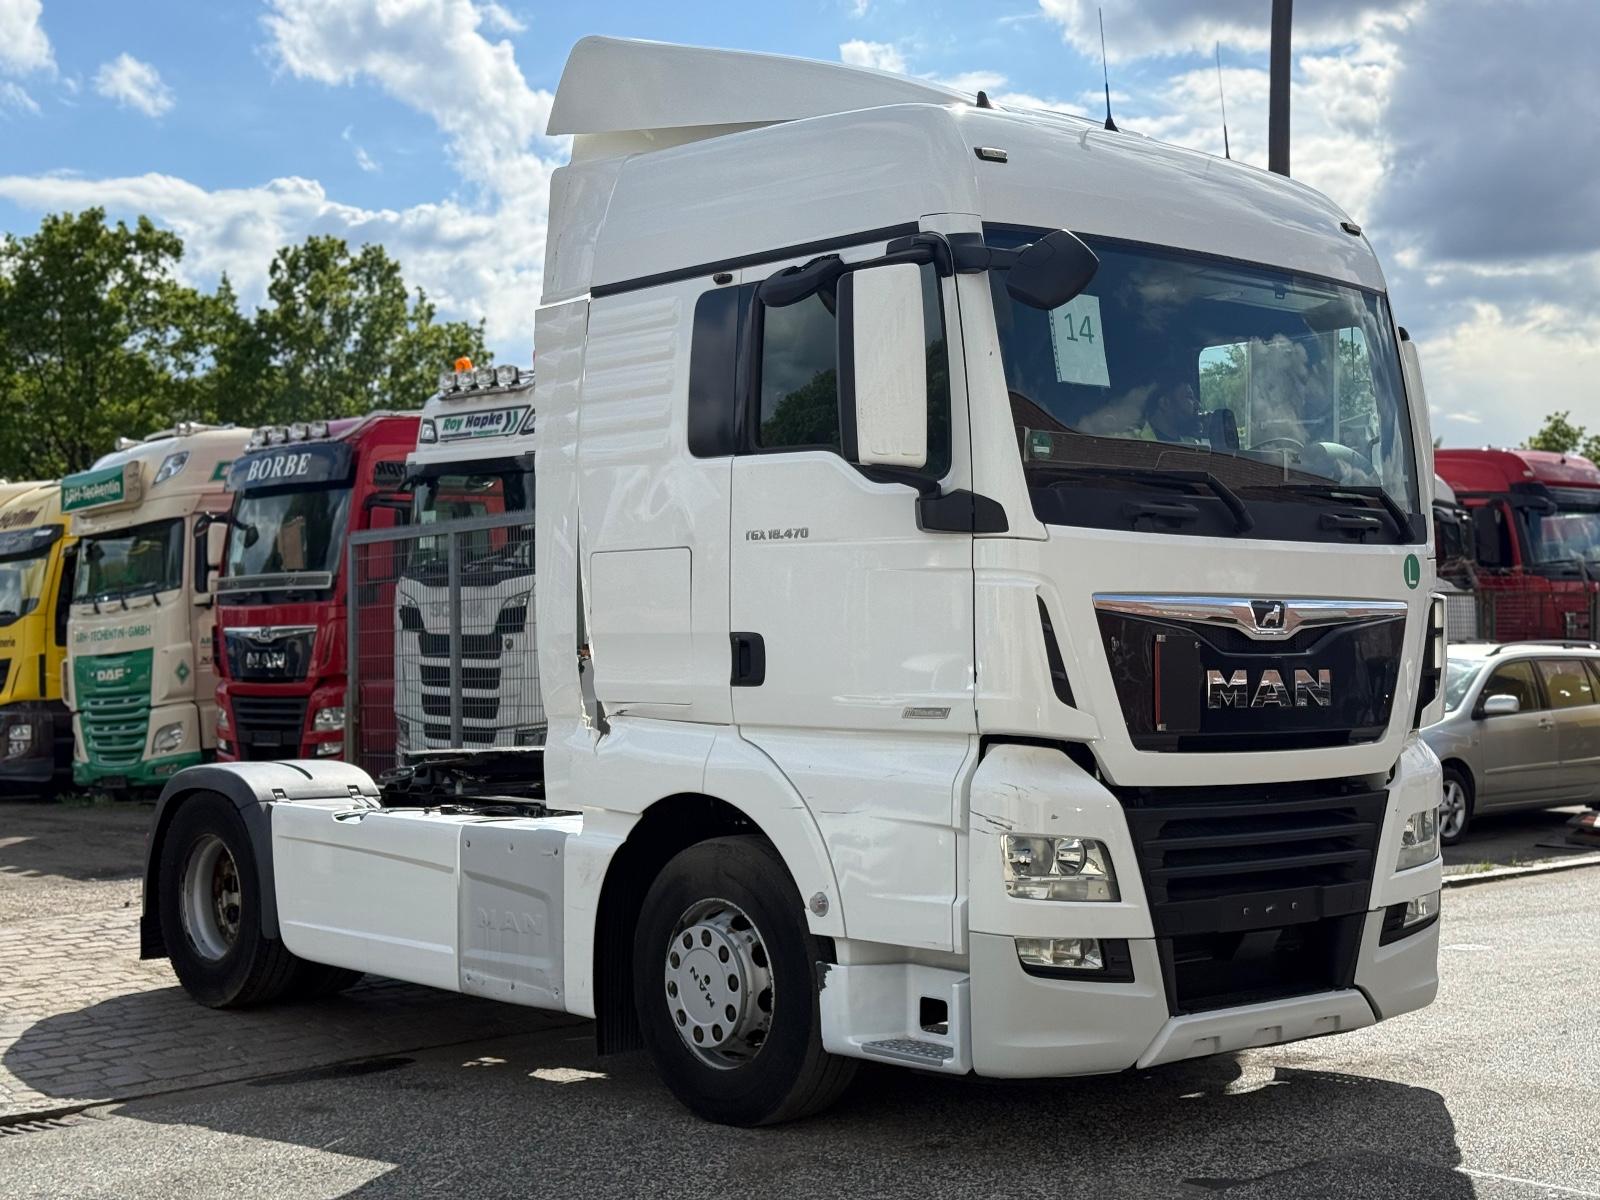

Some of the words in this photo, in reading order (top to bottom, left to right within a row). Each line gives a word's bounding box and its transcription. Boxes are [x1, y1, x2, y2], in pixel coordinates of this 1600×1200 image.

[1064, 313, 1095, 344] 14
[465, 412, 503, 429] Hapke
[247, 453, 312, 481] BORBE
[768, 527, 809, 540] 18.470
[1408, 559, 1417, 585] L
[246, 652, 286, 668] MAN
[96, 667, 125, 681] DAF
[1207, 669, 1332, 709] MAN
[478, 906, 543, 936] MAN
[690, 965, 715, 1008] MAN
